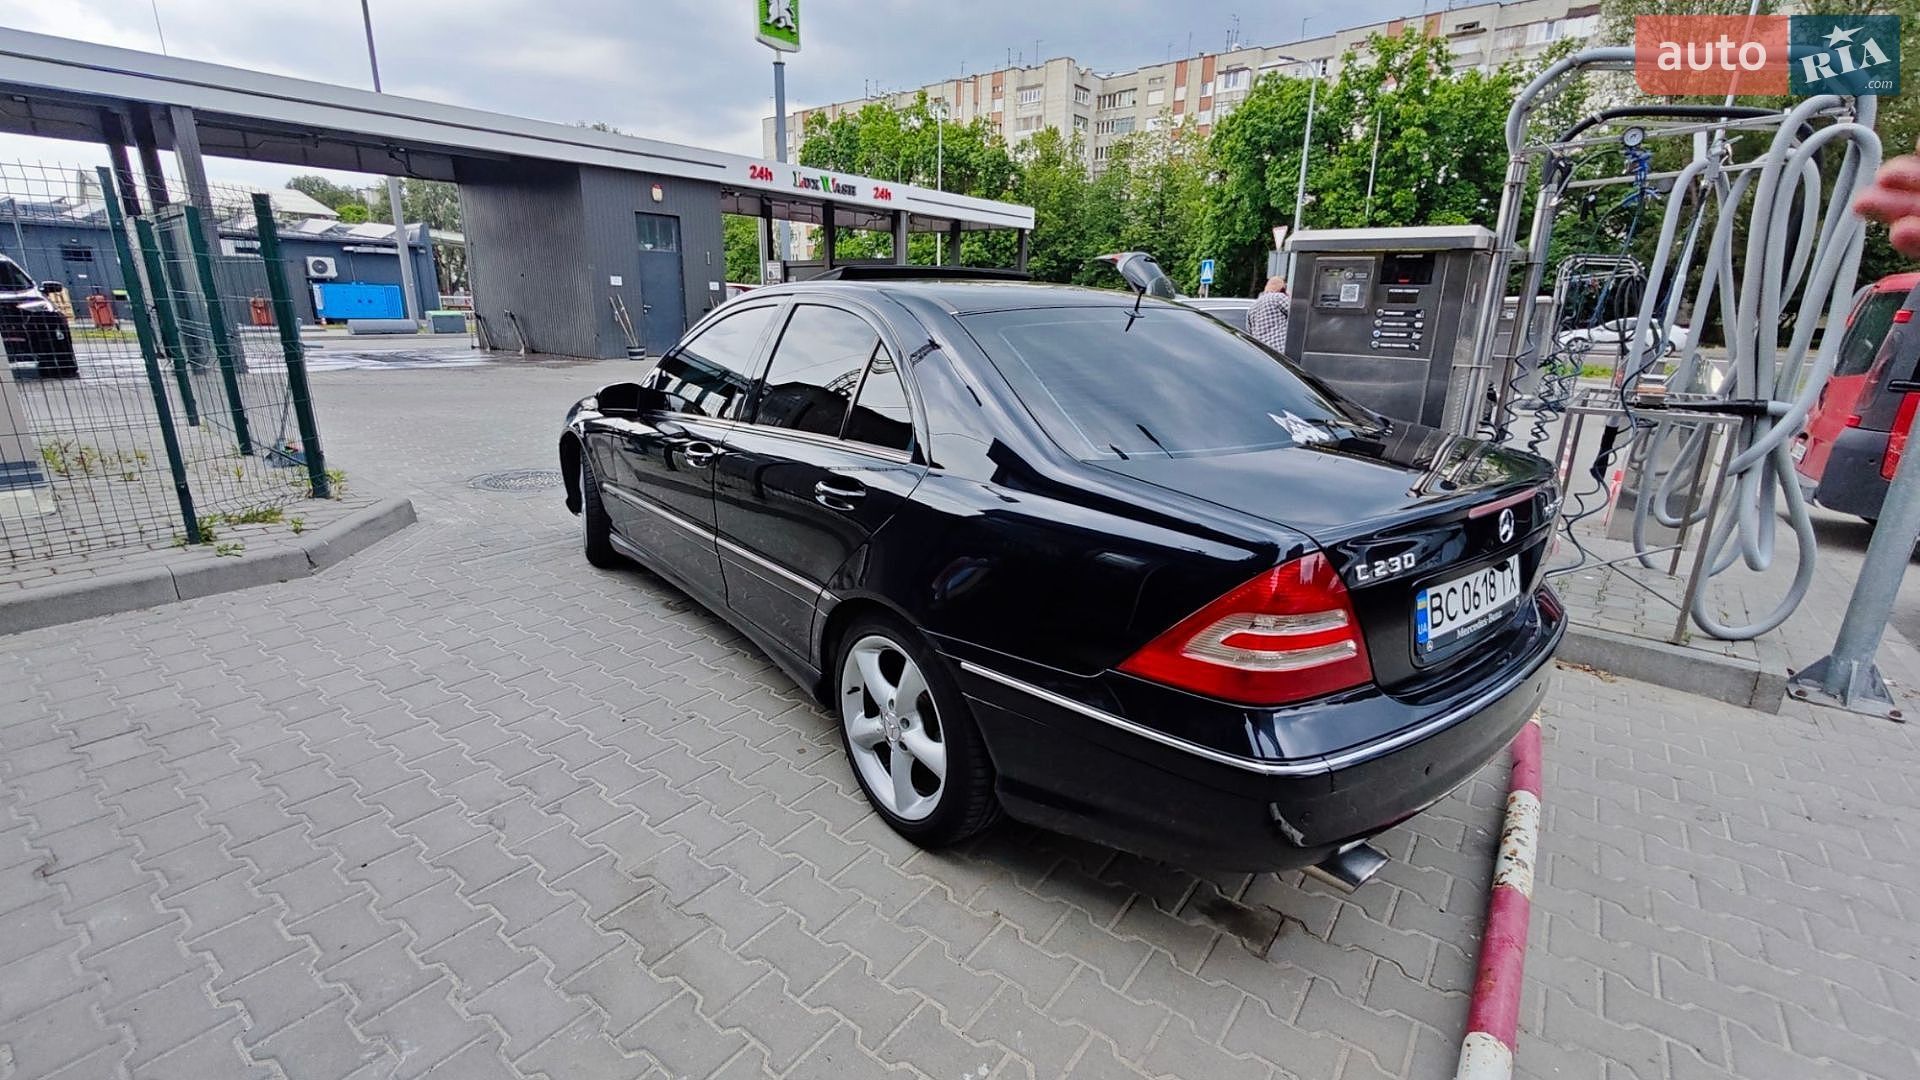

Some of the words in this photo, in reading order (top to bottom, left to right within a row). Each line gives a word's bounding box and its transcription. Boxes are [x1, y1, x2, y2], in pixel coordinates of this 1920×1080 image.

[749, 165, 774, 182] 24h
[873, 187, 892, 201] 24h
[1355, 564, 1370, 581] C
[1374, 553, 1416, 577] 230
[1430, 587, 1458, 629] BC
[1461, 570, 1497, 615] 0618
[1417, 622, 1428, 635] UA
